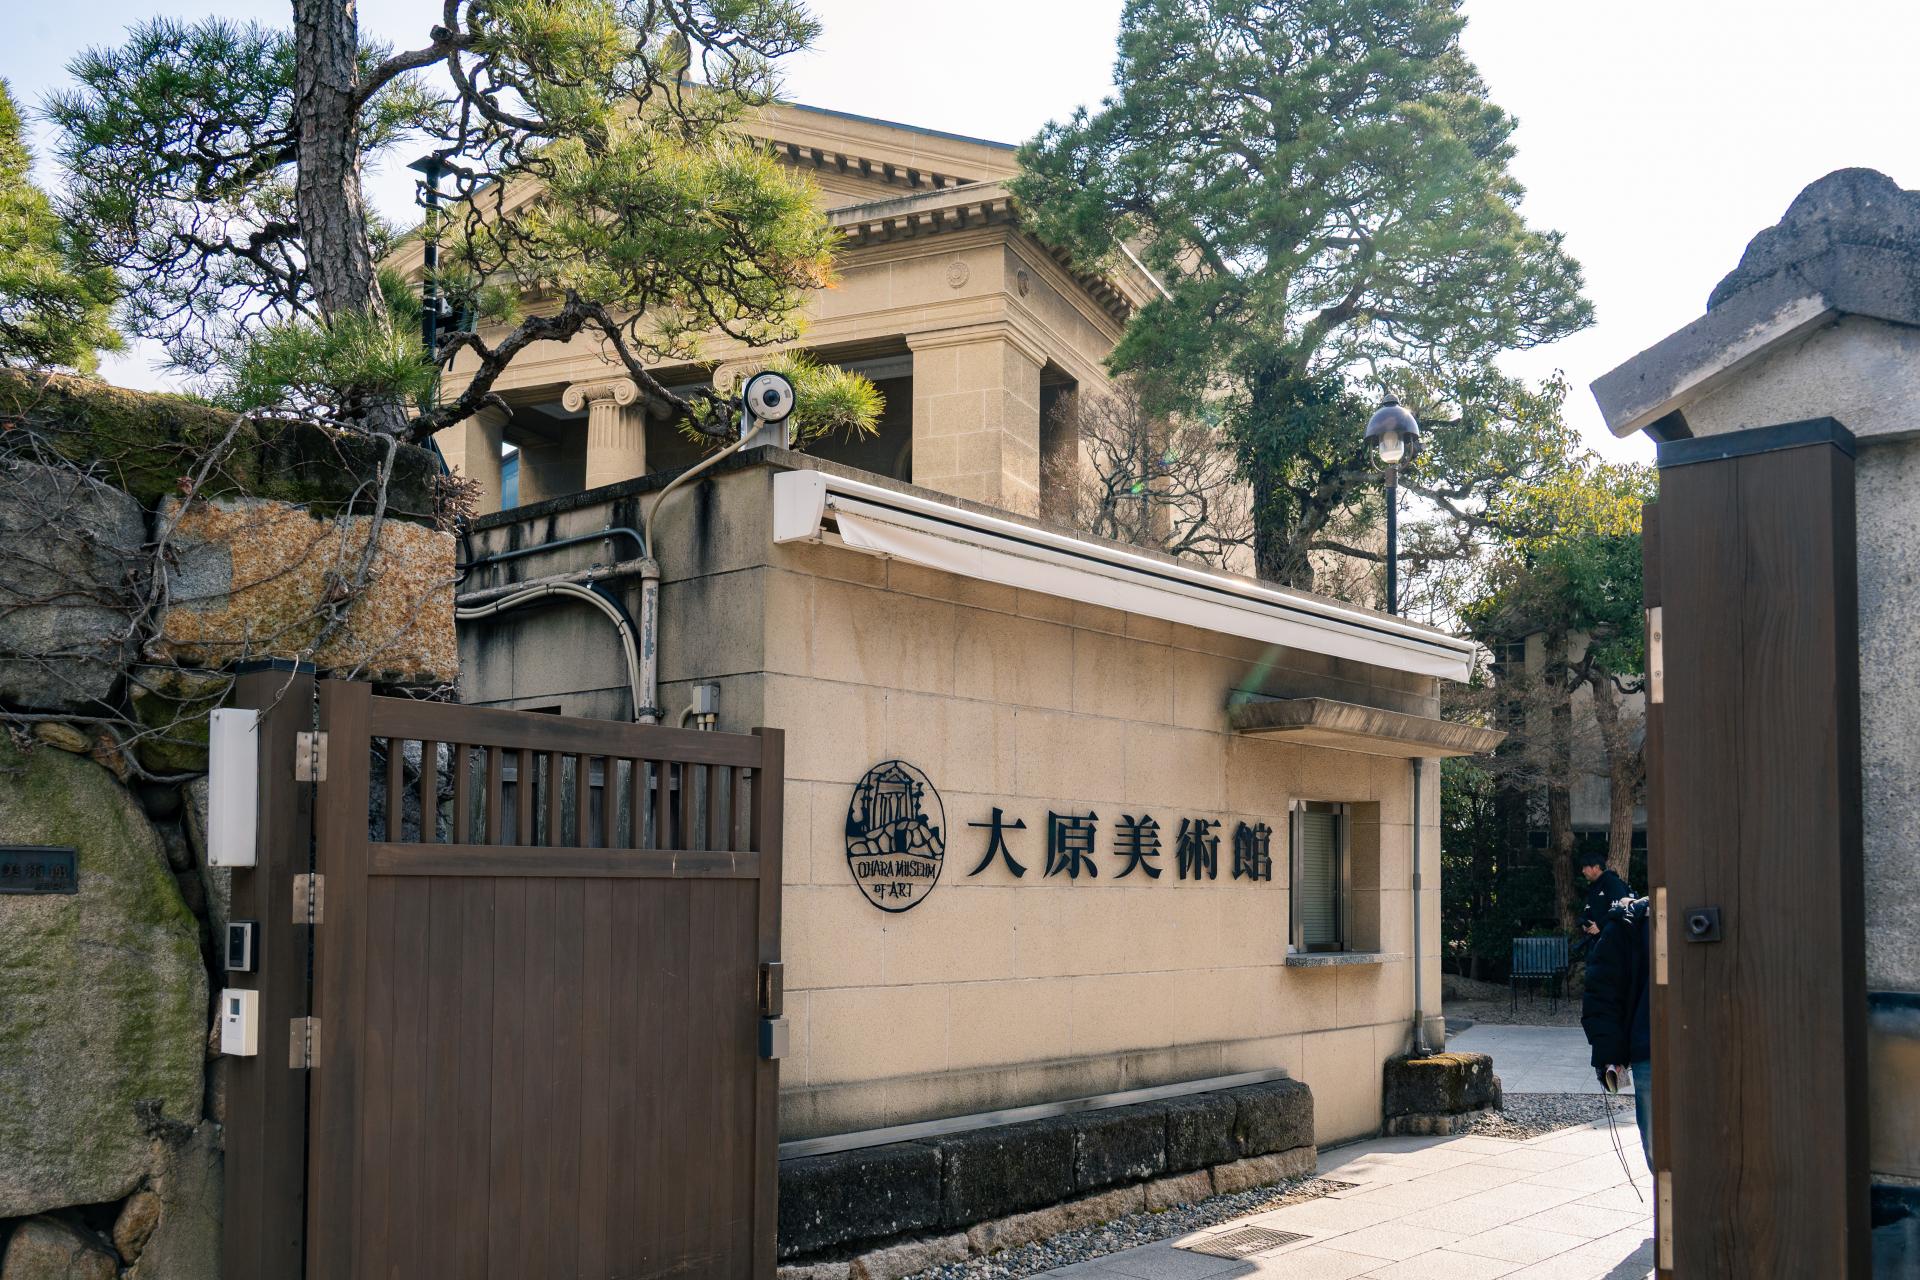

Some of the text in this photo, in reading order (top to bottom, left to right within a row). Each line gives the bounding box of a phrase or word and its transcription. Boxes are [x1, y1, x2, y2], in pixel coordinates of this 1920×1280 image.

[967, 806, 1273, 882] 大原美術館
[857, 860, 936, 879] OHARA MUSEUM
[888, 881, 914, 899] ART
